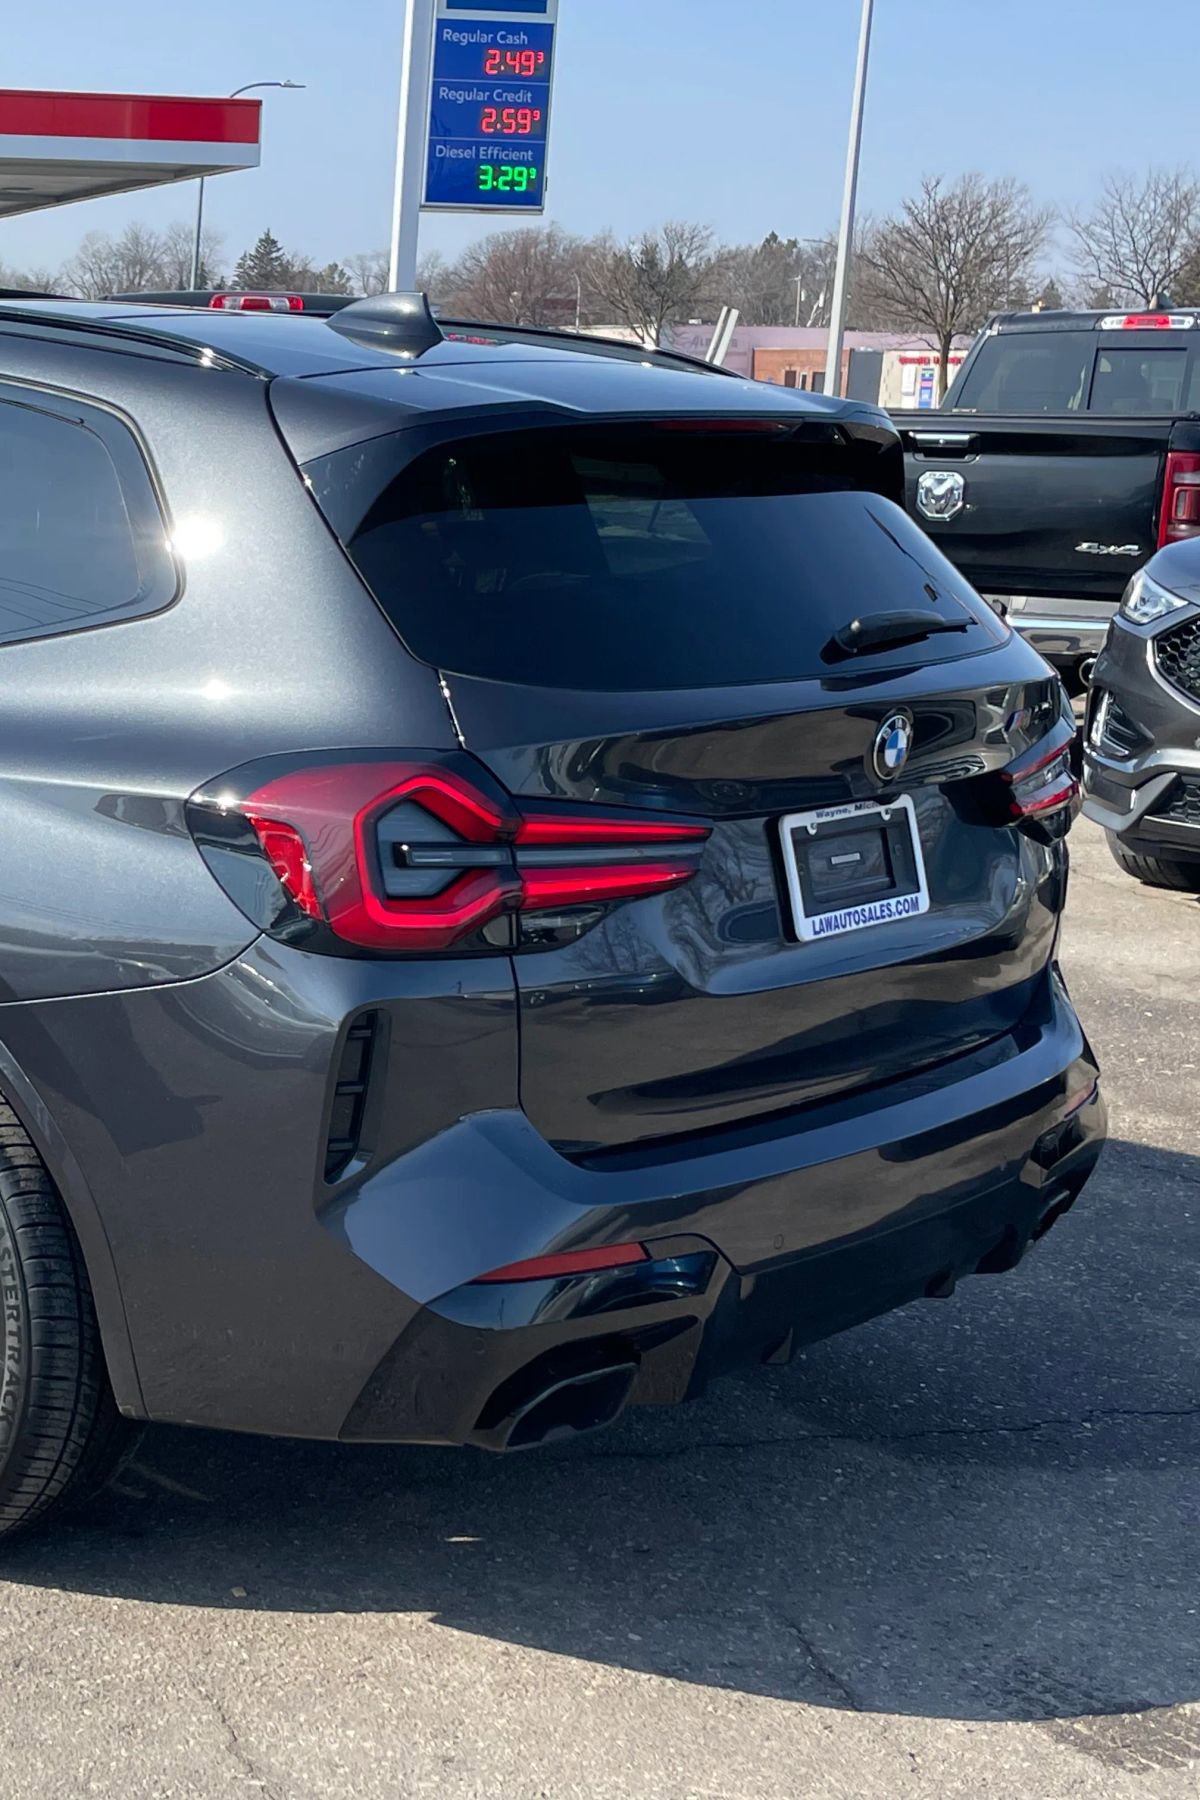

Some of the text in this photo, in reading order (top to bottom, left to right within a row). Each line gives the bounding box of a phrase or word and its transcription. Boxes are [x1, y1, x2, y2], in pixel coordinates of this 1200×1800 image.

[443, 29, 528, 45] Regular Cash
[438, 87, 532, 104] Regular Credit
[435, 145, 533, 161] Diesel Efficient
[815, 807, 852, 819] Wayne,
[811, 895, 920, 936] LAWAUTOSALES.COM
